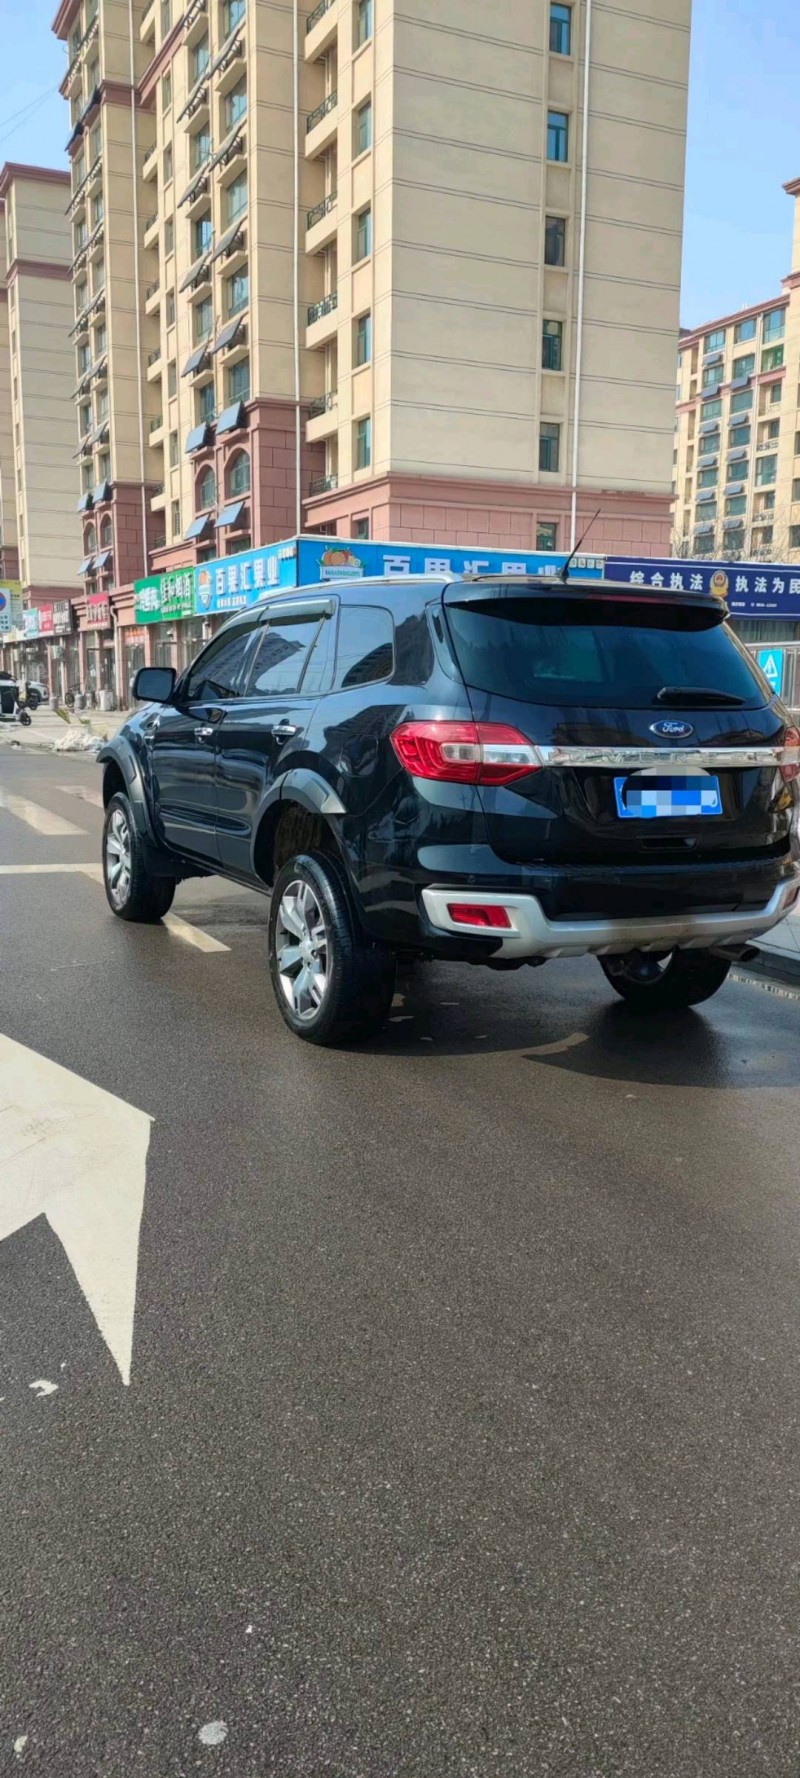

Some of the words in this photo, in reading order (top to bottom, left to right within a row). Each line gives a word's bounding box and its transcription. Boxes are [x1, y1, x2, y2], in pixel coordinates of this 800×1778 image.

[214, 556, 279, 595] 百果汇果业
[629, 571, 703, 592] 综合执法
[735, 575, 800, 594] 执法为民
[662, 721, 685, 733] Ford
